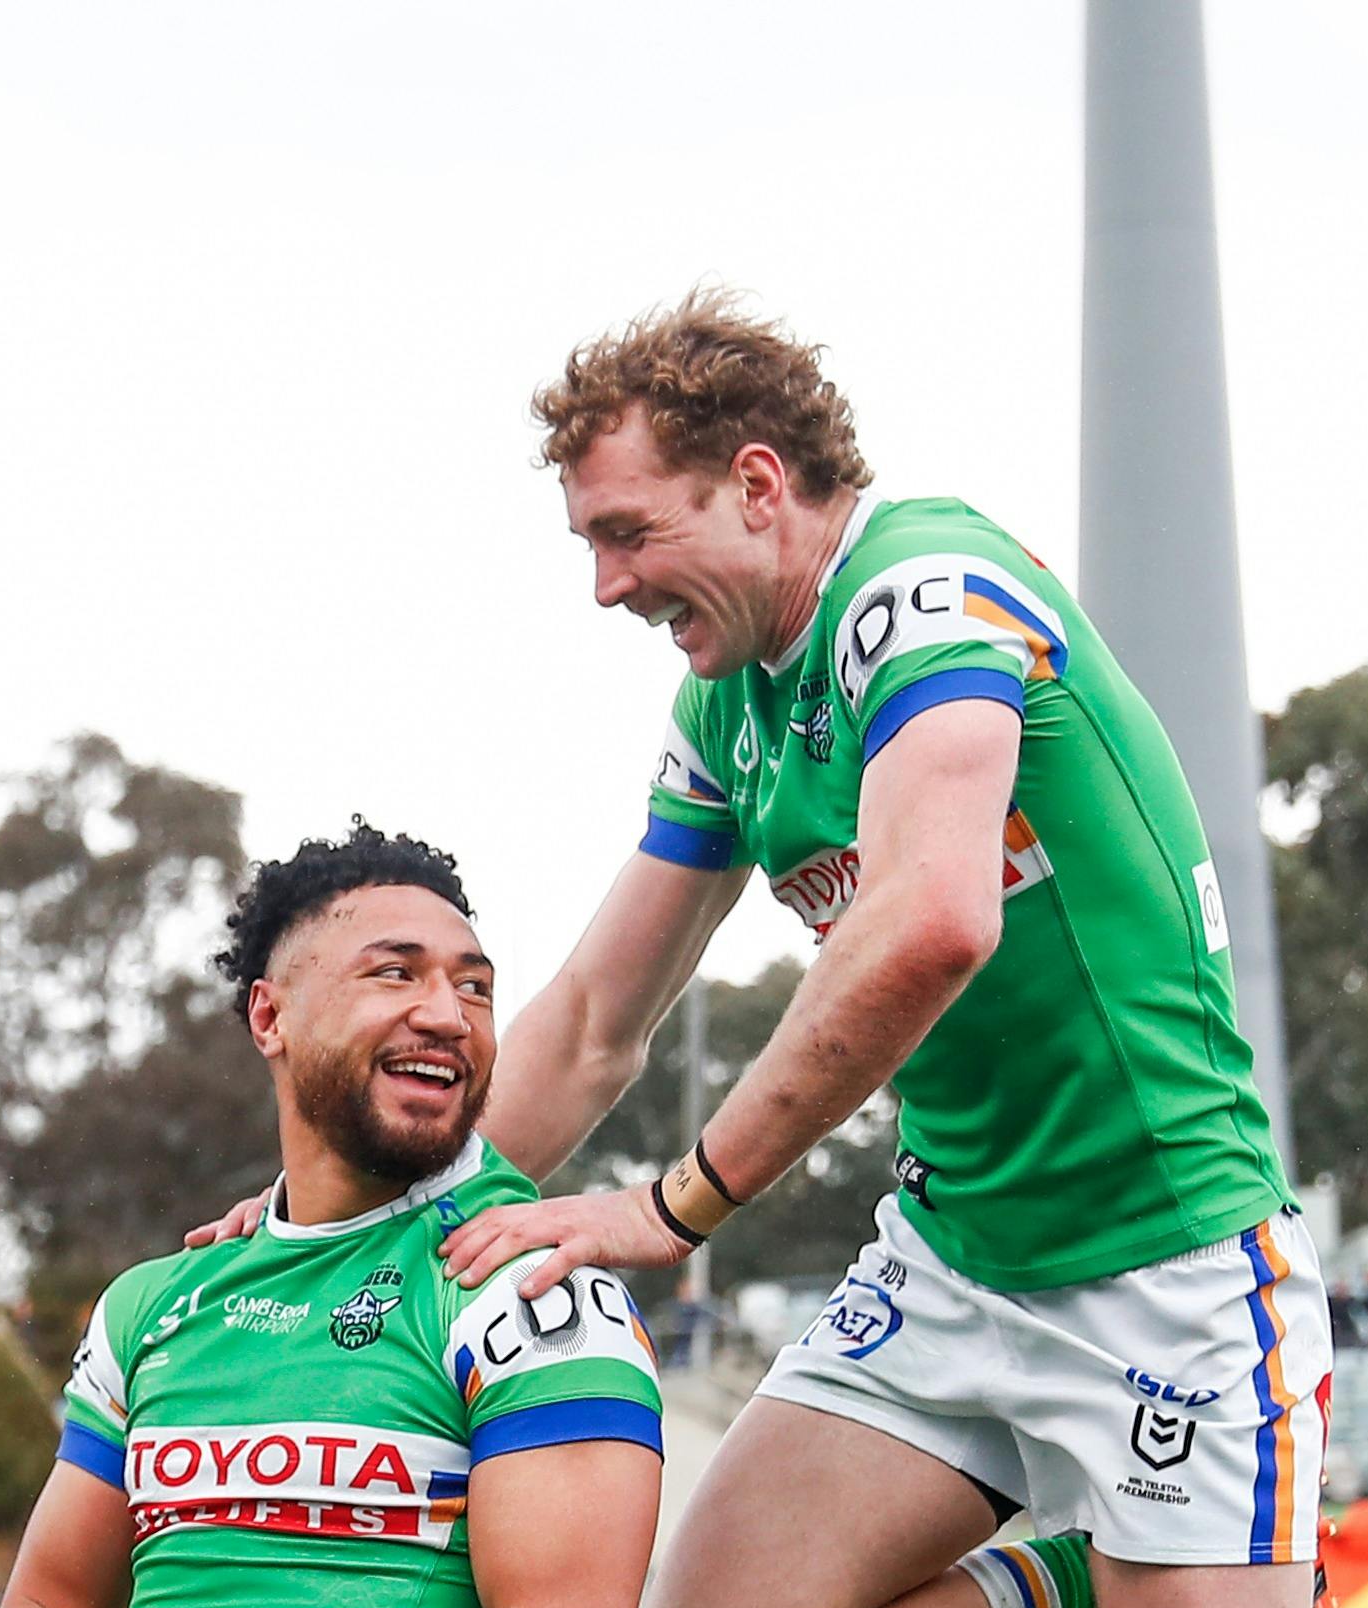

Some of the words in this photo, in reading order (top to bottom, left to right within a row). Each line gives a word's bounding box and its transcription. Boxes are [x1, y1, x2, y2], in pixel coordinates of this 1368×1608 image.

[363, 1270, 404, 1287] DERS
[131, 1434, 418, 1495] TOYOTA
[1116, 1483, 1191, 1506] PREMIERSHIP
